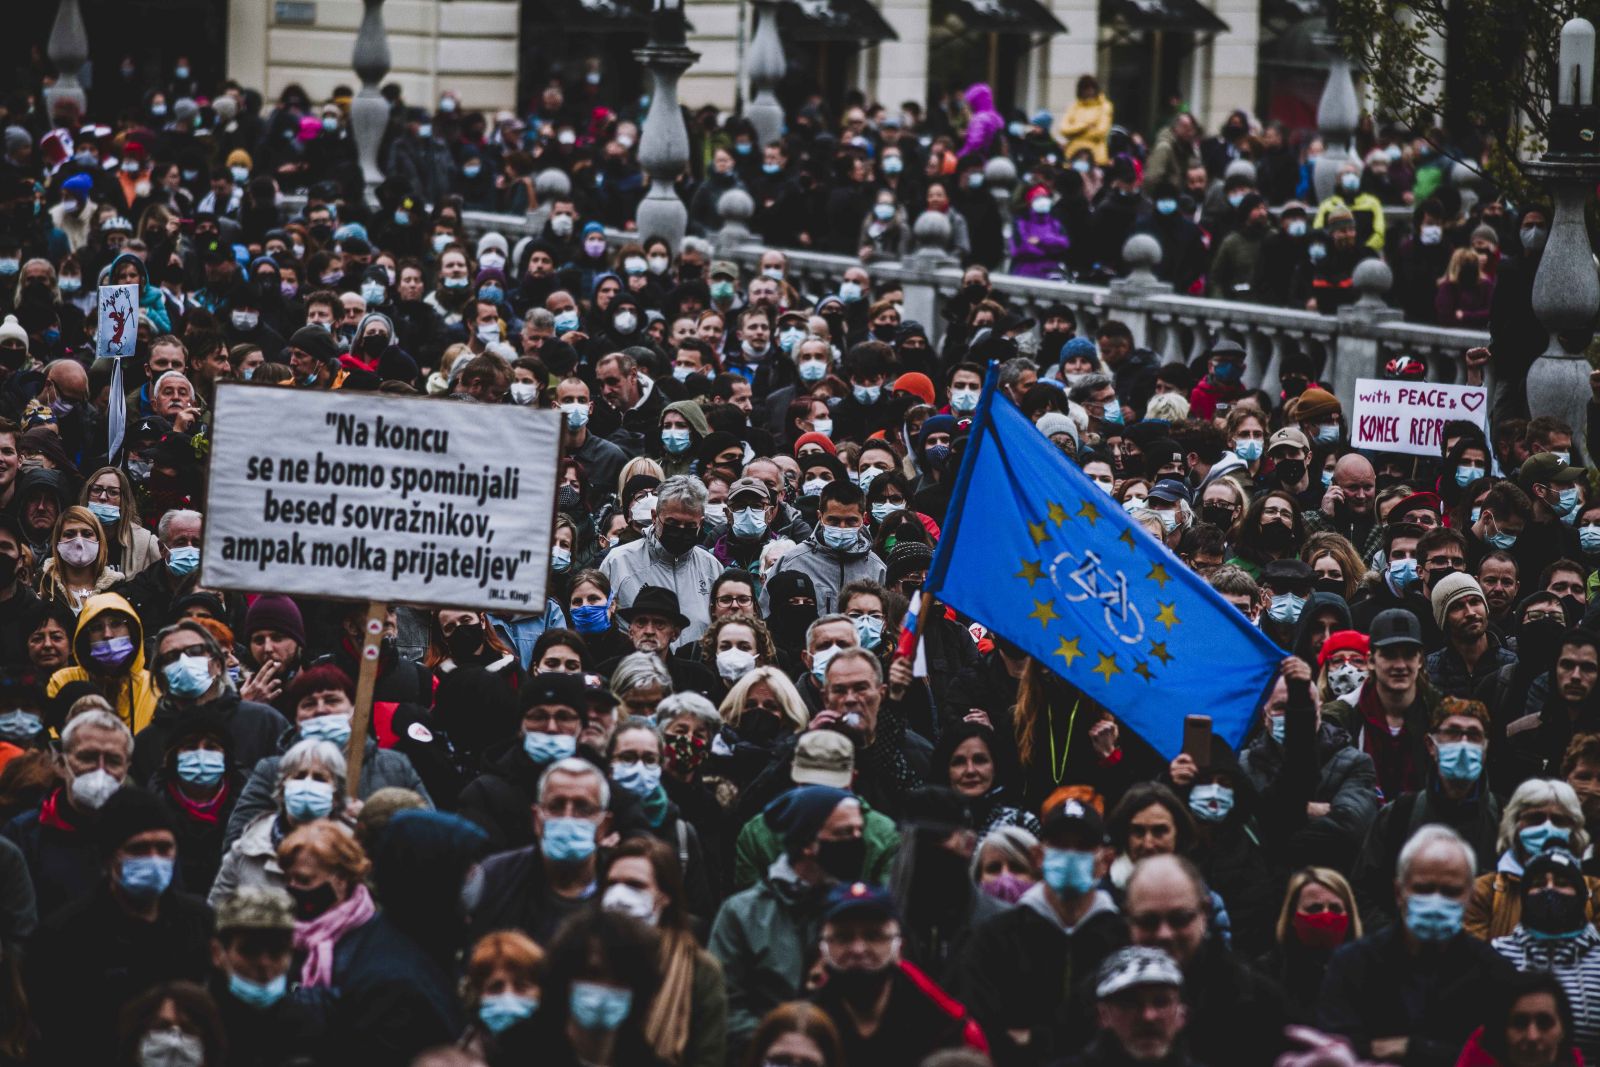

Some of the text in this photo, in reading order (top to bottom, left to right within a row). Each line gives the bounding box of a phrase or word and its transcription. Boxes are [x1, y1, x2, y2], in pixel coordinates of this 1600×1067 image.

[1360, 389, 1457, 409] with PEACE &
[325, 412, 450, 454] "Na koncu
[1359, 414, 1446, 447] KONEC REPR
[247, 451, 520, 507] se ne bomo spominjali
[264, 489, 495, 544] besed sovražnikov,
[221, 531, 531, 589] ampak molka prijateljev"
